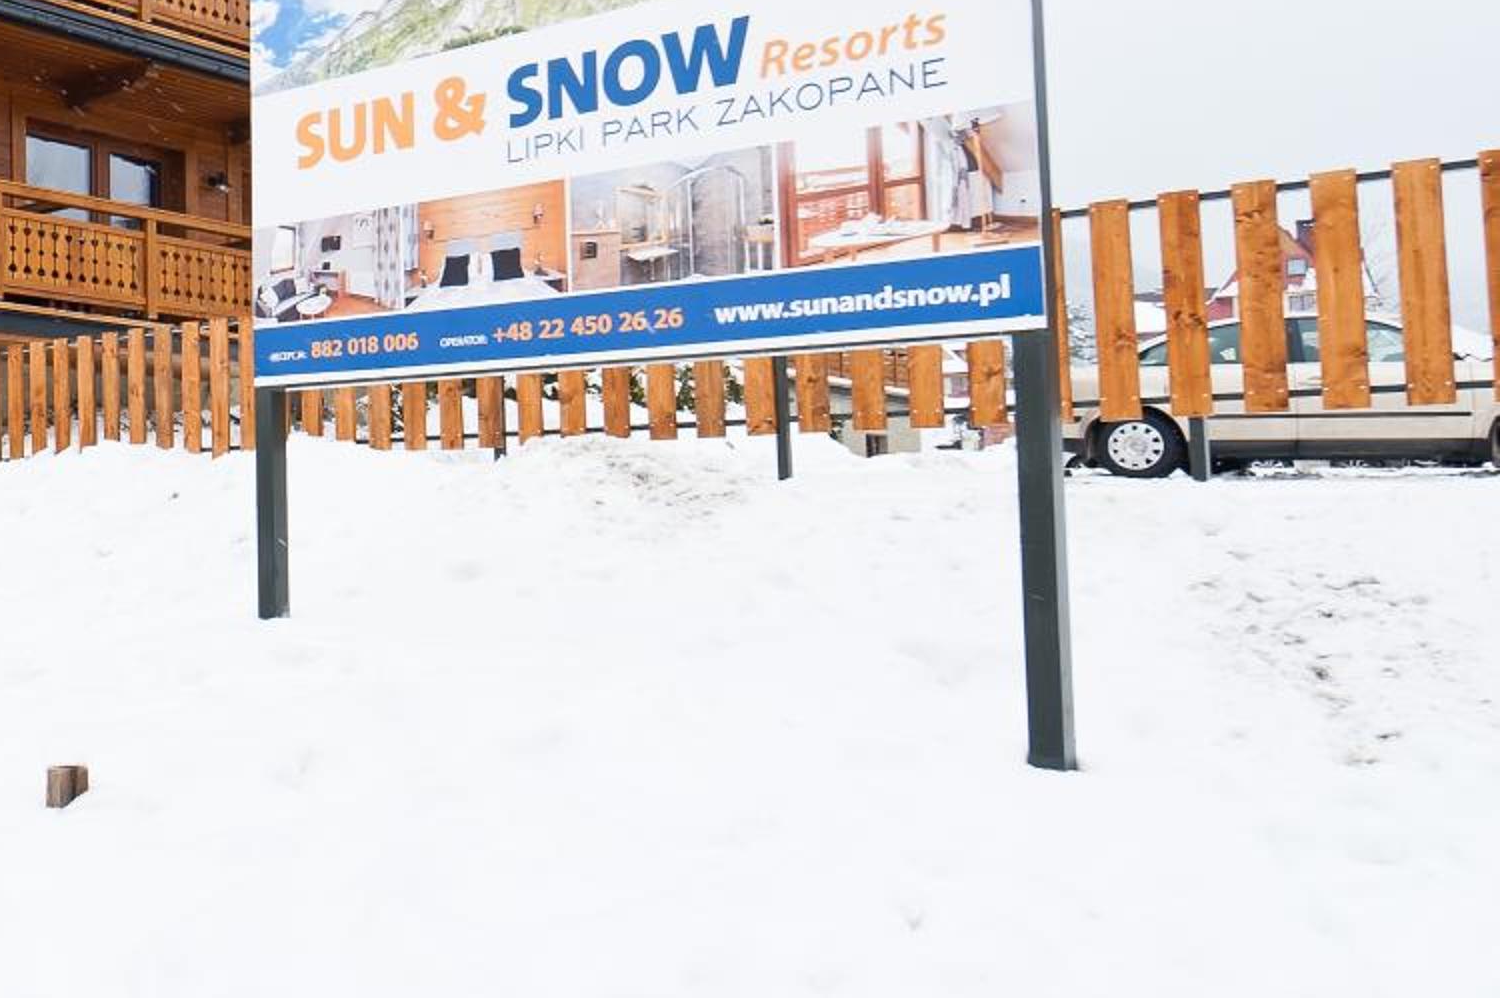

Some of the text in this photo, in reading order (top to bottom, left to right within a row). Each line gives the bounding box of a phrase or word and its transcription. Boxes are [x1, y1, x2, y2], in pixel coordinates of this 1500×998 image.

[295, 12, 947, 170] SUN & SNOW Resorts
[507, 57, 948, 163] LIPKI PARK ZAKOPANE
[493, 321, 533, 343] +48
[539, 318, 565, 339] 22
[571, 313, 613, 336] 450
[619, 310, 648, 333] 26
[653, 307, 684, 330] 26
[714, 273, 1012, 325] www.sunandsnow.pl
[311, 340, 343, 359] 882
[347, 335, 379, 355] 018
[383, 332, 419, 352] 006
